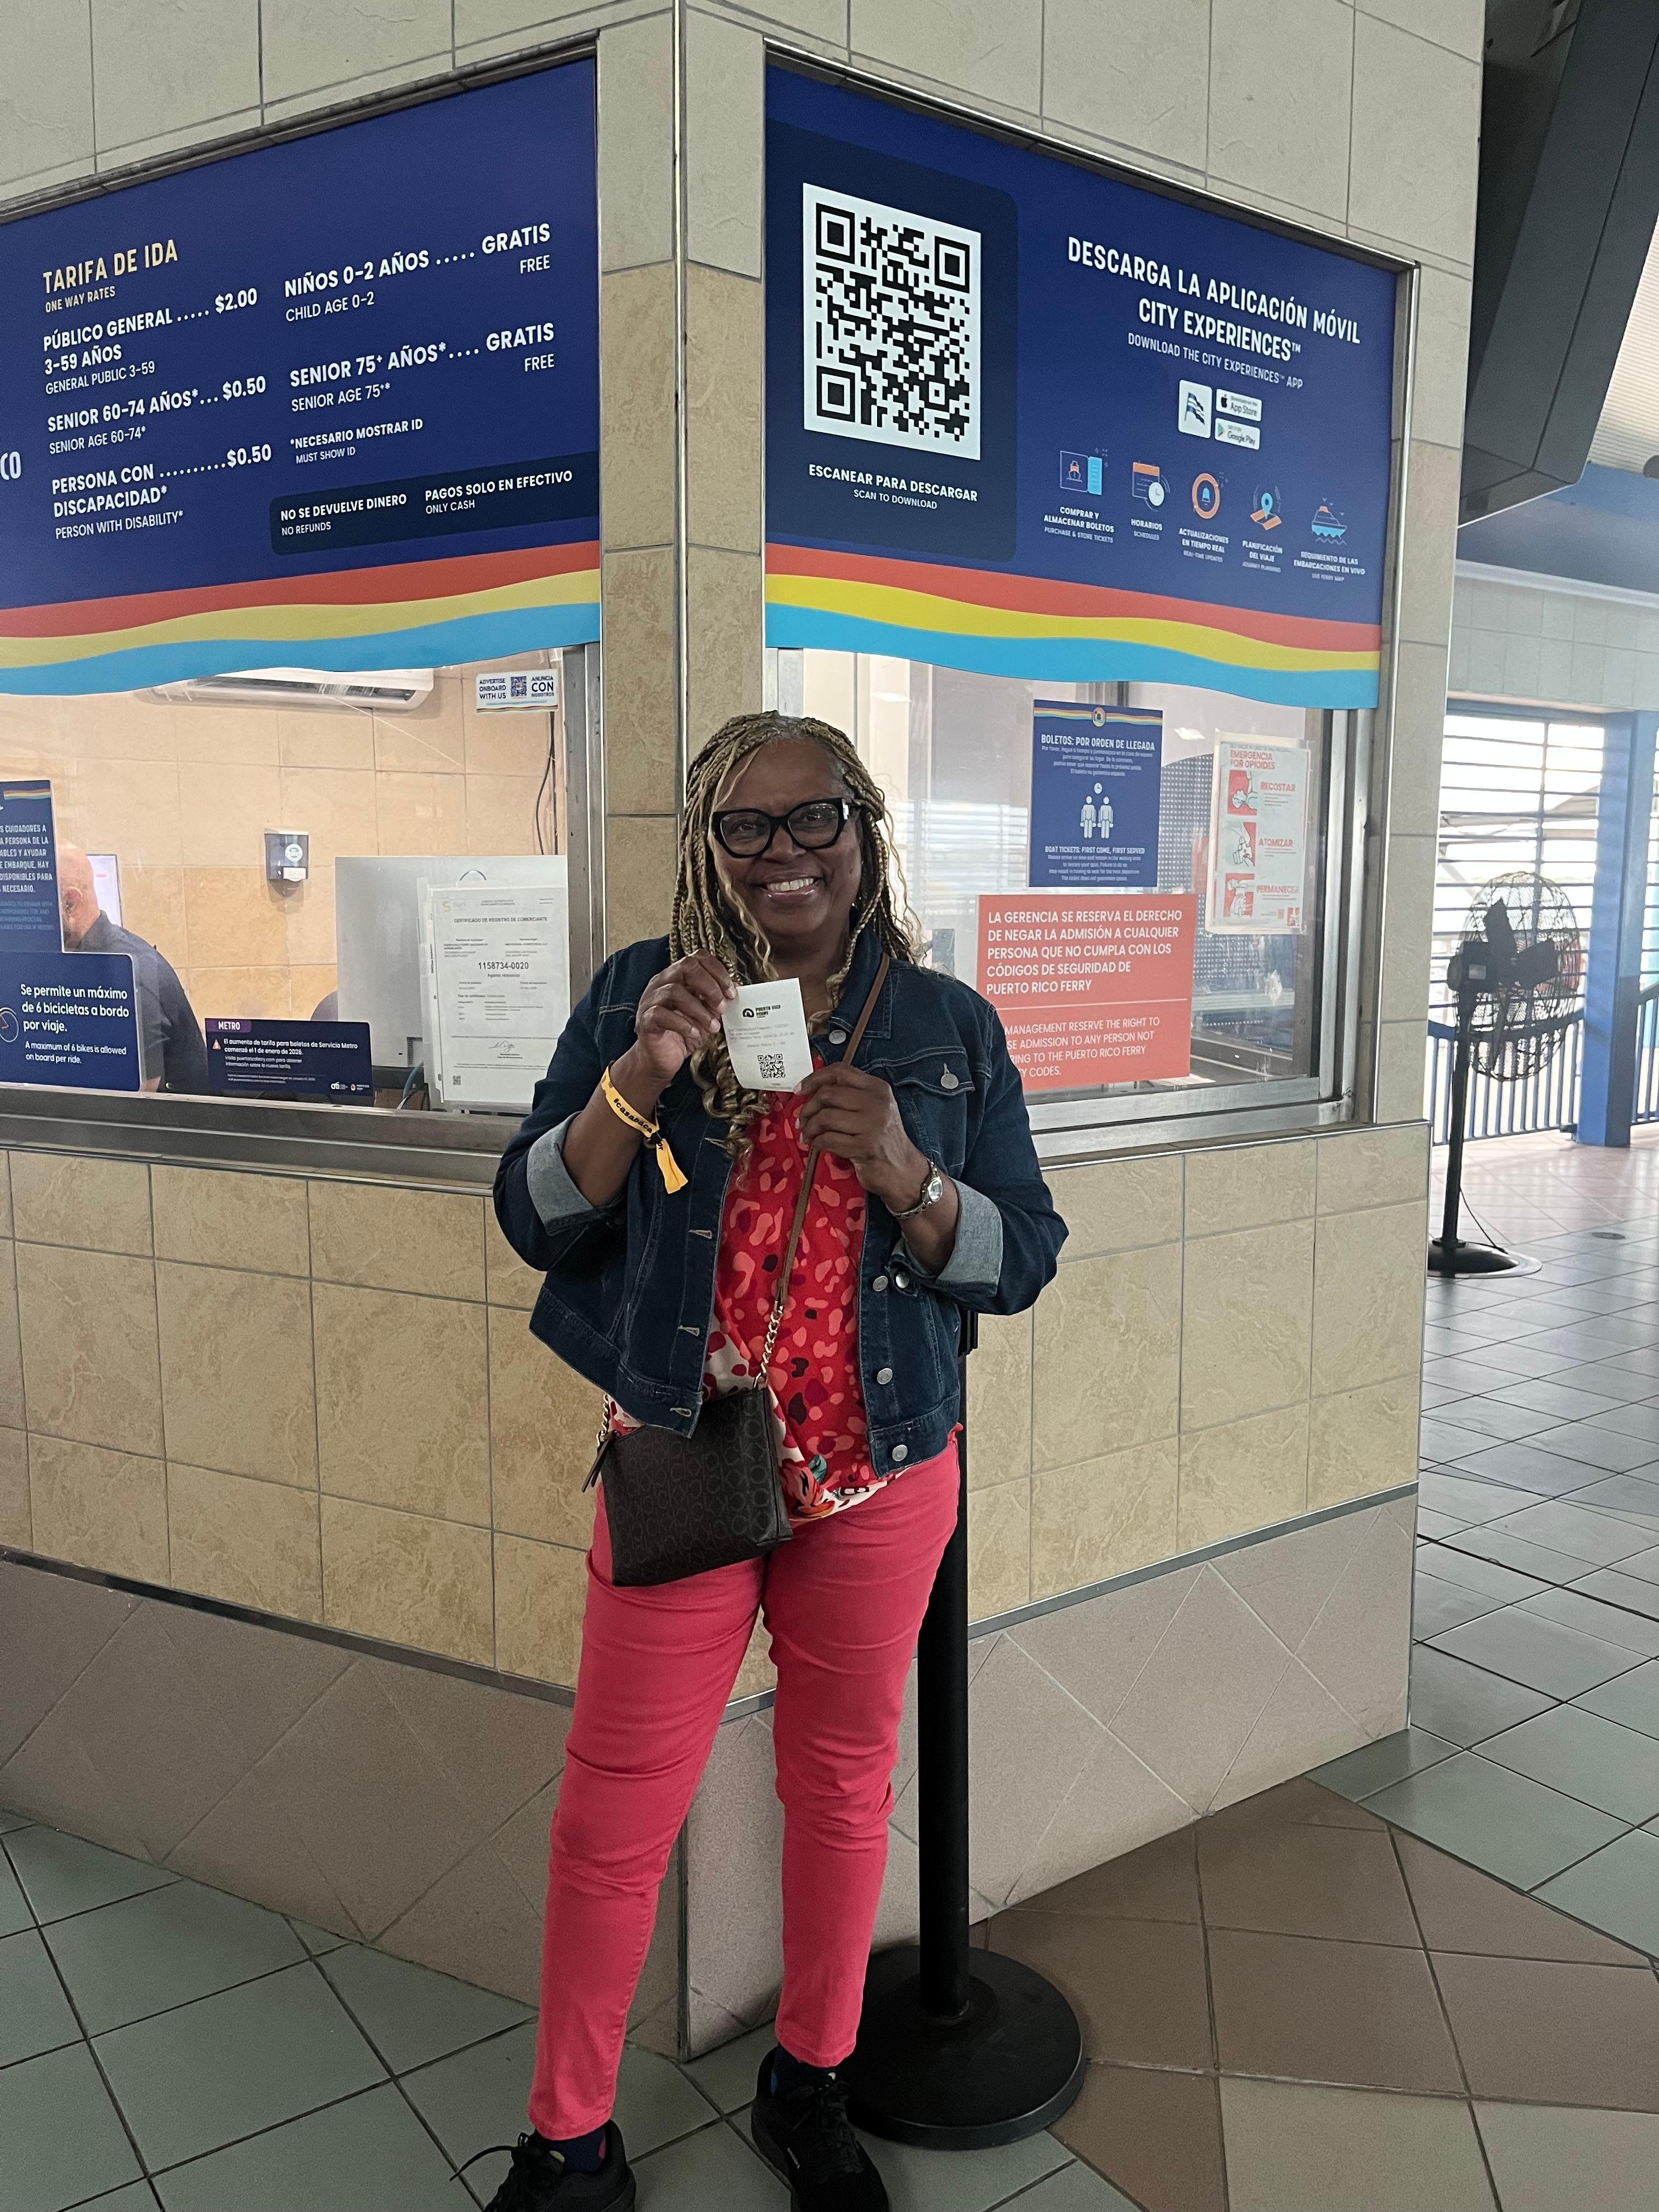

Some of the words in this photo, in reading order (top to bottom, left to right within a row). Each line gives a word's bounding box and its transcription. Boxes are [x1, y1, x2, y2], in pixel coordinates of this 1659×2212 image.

[43, 257, 107, 293] TARIFA
[114, 249, 137, 275] DE
[145, 239, 177, 268] IDA
[285, 270, 338, 297] NIÑOS
[343, 261, 374, 284] 0-2
[379, 250, 428, 277] AÑOS
[482, 223, 550, 253] GRATIS
[520, 255, 550, 273] FREE
[1069, 236, 1171, 289] DESCARGA
[1178, 269, 1200, 297] LA
[1206, 279, 1307, 329] APLICACIÓN
[1313, 308, 1360, 343] MÓVIL
[46, 298, 62, 312] ONE
[65, 292, 84, 307] WAY
[87, 286, 115, 302] RATES
[286, 303, 320, 321] CHILD
[325, 297, 348, 314] AGE
[352, 291, 374, 308] 0-2
[43, 324, 103, 351] PÚBLICO
[107, 308, 172, 336] GENERAL
[215, 287, 257, 313] $2.00
[1139, 298, 1178, 329] CITY
[45, 353, 77, 374] 3-59
[82, 344, 121, 367] AÑOS
[290, 360, 351, 387] SENIOR
[486, 323, 554, 351] GRATIS
[524, 353, 554, 371] FREE
[1128, 332, 1180, 356] DOWNLOAD
[1183, 347, 1199, 362] THE
[1202, 352, 1222, 367] CITY
[1286, 376, 1303, 388] APP
[46, 375, 89, 394] GENERAL
[92, 367, 126, 385] PUBLIC
[129, 360, 154, 377] 3-59
[292, 393, 334, 411] SENIOR
[338, 387, 361, 404] AGE
[48, 408, 98, 431] SENIOR
[103, 399, 145, 421] 60-74
[356, 421, 408, 438] MOSTRAR
[411, 419, 422, 430] ID
[49, 437, 84, 454] SENIOR
[88, 433, 108, 447] AGE
[296, 452, 318, 463] MUST
[320, 448, 345, 460] SHOW
[347, 447, 355, 455] ID
[52, 470, 117, 494] PERSONA
[121, 464, 154, 483] CON
[425, 486, 462, 501] PAGOS
[466, 481, 495, 495] SOLO
[499, 478, 513, 490] EN
[517, 470, 572, 488] EFECTIVO
[809, 464, 872, 484] ESCANEAR
[876, 475, 907, 490] PARA
[910, 480, 977, 501] DESCARGAR
[281, 509, 296, 521] NO
[298, 507, 310, 518] SE
[313, 499, 363, 516] DEVUELVE
[366, 494, 407, 509] DINERO
[426, 503, 448, 514] ONLY
[450, 499, 475, 510] CASH
[854, 489, 876, 500] SCAN
[879, 493, 889, 501] TO
[892, 495, 937, 509] DOWNLOAD
[1060, 506, 1093, 518] COMPRAR
[55, 523, 93, 539] PERSON
[96, 518, 122, 533] WITH
[282, 526, 294, 535] NO
[296, 521, 331, 534] REFUNDS
[1044, 515, 1084, 527] ALMACENAR
[1086, 521, 1114, 532] BOLETOS
[1131, 518, 1162, 530] HORARIOS
[532, 681, 553, 692] CON
[1041, 734, 1074, 744] BOLETOS:
[1076, 737, 1090, 746] POR
[1091, 737, 1114, 747] ORDEN
[1116, 740, 1124, 748] DE
[1126, 740, 1155, 750] LLEGADA
[1260, 781, 1295, 791] RECOSTAR
[1259, 838, 1293, 847] ATOMIZAR
[989, 912, 1001, 923] LA
[1004, 911, 1058, 923] GERENCIA
[1062, 911, 1073, 922] SE
[1076, 910, 1120, 922] RESERVA
[1124, 910, 1133, 921] EL
[1136, 910, 1182, 921] DERECHO
[988, 929, 1002, 941] DE
[1005, 929, 1041, 940] NEGAR
[1045, 928, 1057, 940] LA
[1059, 925, 1111, 939] ADMISIÓN
[1114, 928, 1121, 938] A
[1124, 927, 1178, 939] CUALQUIER
[988, 946, 1038, 959] PERSONA
[1041, 946, 1062, 959] QUE
[1065, 945, 1081, 957] NO
[1084, 944, 1125, 956] CUMPLA
[1128, 944, 1150, 955] CON
[1153, 943, 1171, 953] LOS
[987, 962, 1039, 977] CÓDIGOS
[1041, 963, 1054, 975] DE
[1057, 962, 1116, 974] SEGURIDAD
[1119, 961, 1131, 972] DE
[21, 984, 32, 995] Se
[33, 985, 71, 998] permite
[73, 989, 86, 997] un
[87, 985, 127, 999] máximo
[986, 982, 1029, 995] PUERTO
[1031, 981, 1058, 992] RICO
[1060, 979, 1091, 991] FERRY
[22, 1001, 34, 1012] de
[36, 1001, 41, 1013] 6
[43, 1002, 89, 1015] bicicletas
[91, 1007, 98, 1015] a
[100, 1005, 129, 1017] bordo
[23, 1020, 40, 1031] por
[41, 1020, 67, 1034] viaje.
[218, 1021, 240, 1030] METRO
[1006, 1022, 1066, 1036] MANAGEMENT
[1069, 1020, 1103, 1031] RESERVE
[1105, 1019, 1120, 1028] THE
[1122, 1017, 1147, 1028] RIGHT
[1149, 1017, 1159, 1025] TO
[1020, 1037, 1068, 1048] ADMISSION
[1071, 1035, 1082, 1045] TO
[1084, 1034, 1101, 1043] ANY
[1103, 1032, 1135, 1042] PERSON
[1137, 1030, 1154, 1040] NOT
[1033, 1052, 1045, 1062] TO
[1048, 1051, 1063, 1060] THE
[1065, 1048, 1097, 1059] PUERTO
[1099, 1047, 1120, 1057] RICO
[1122, 1045, 1146, 1055] FERRY
[1029, 1065, 1060, 1077] CODES.
